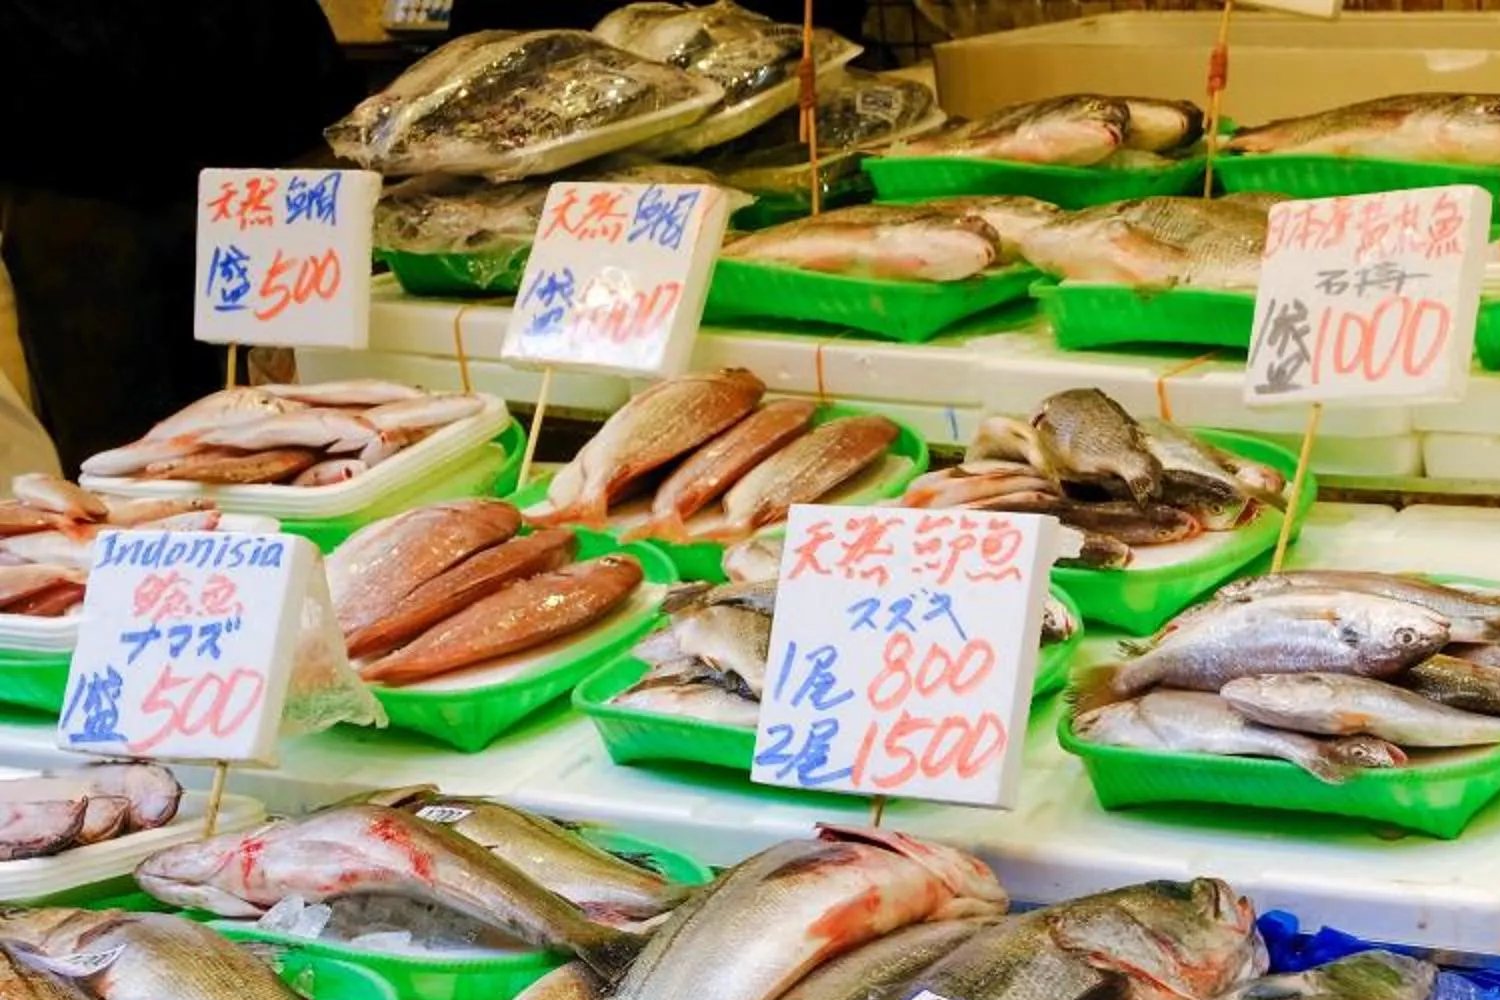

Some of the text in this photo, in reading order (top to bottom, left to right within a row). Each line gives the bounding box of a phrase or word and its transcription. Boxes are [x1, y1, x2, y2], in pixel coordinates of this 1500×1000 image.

[255, 248, 341, 321] 500
[1311, 294, 1452, 386] 1000
[96, 531, 285, 569] Indonisia
[122, 664, 266, 751] 500
[866, 631, 997, 713] 800
[850, 710, 1009, 789] 1500
